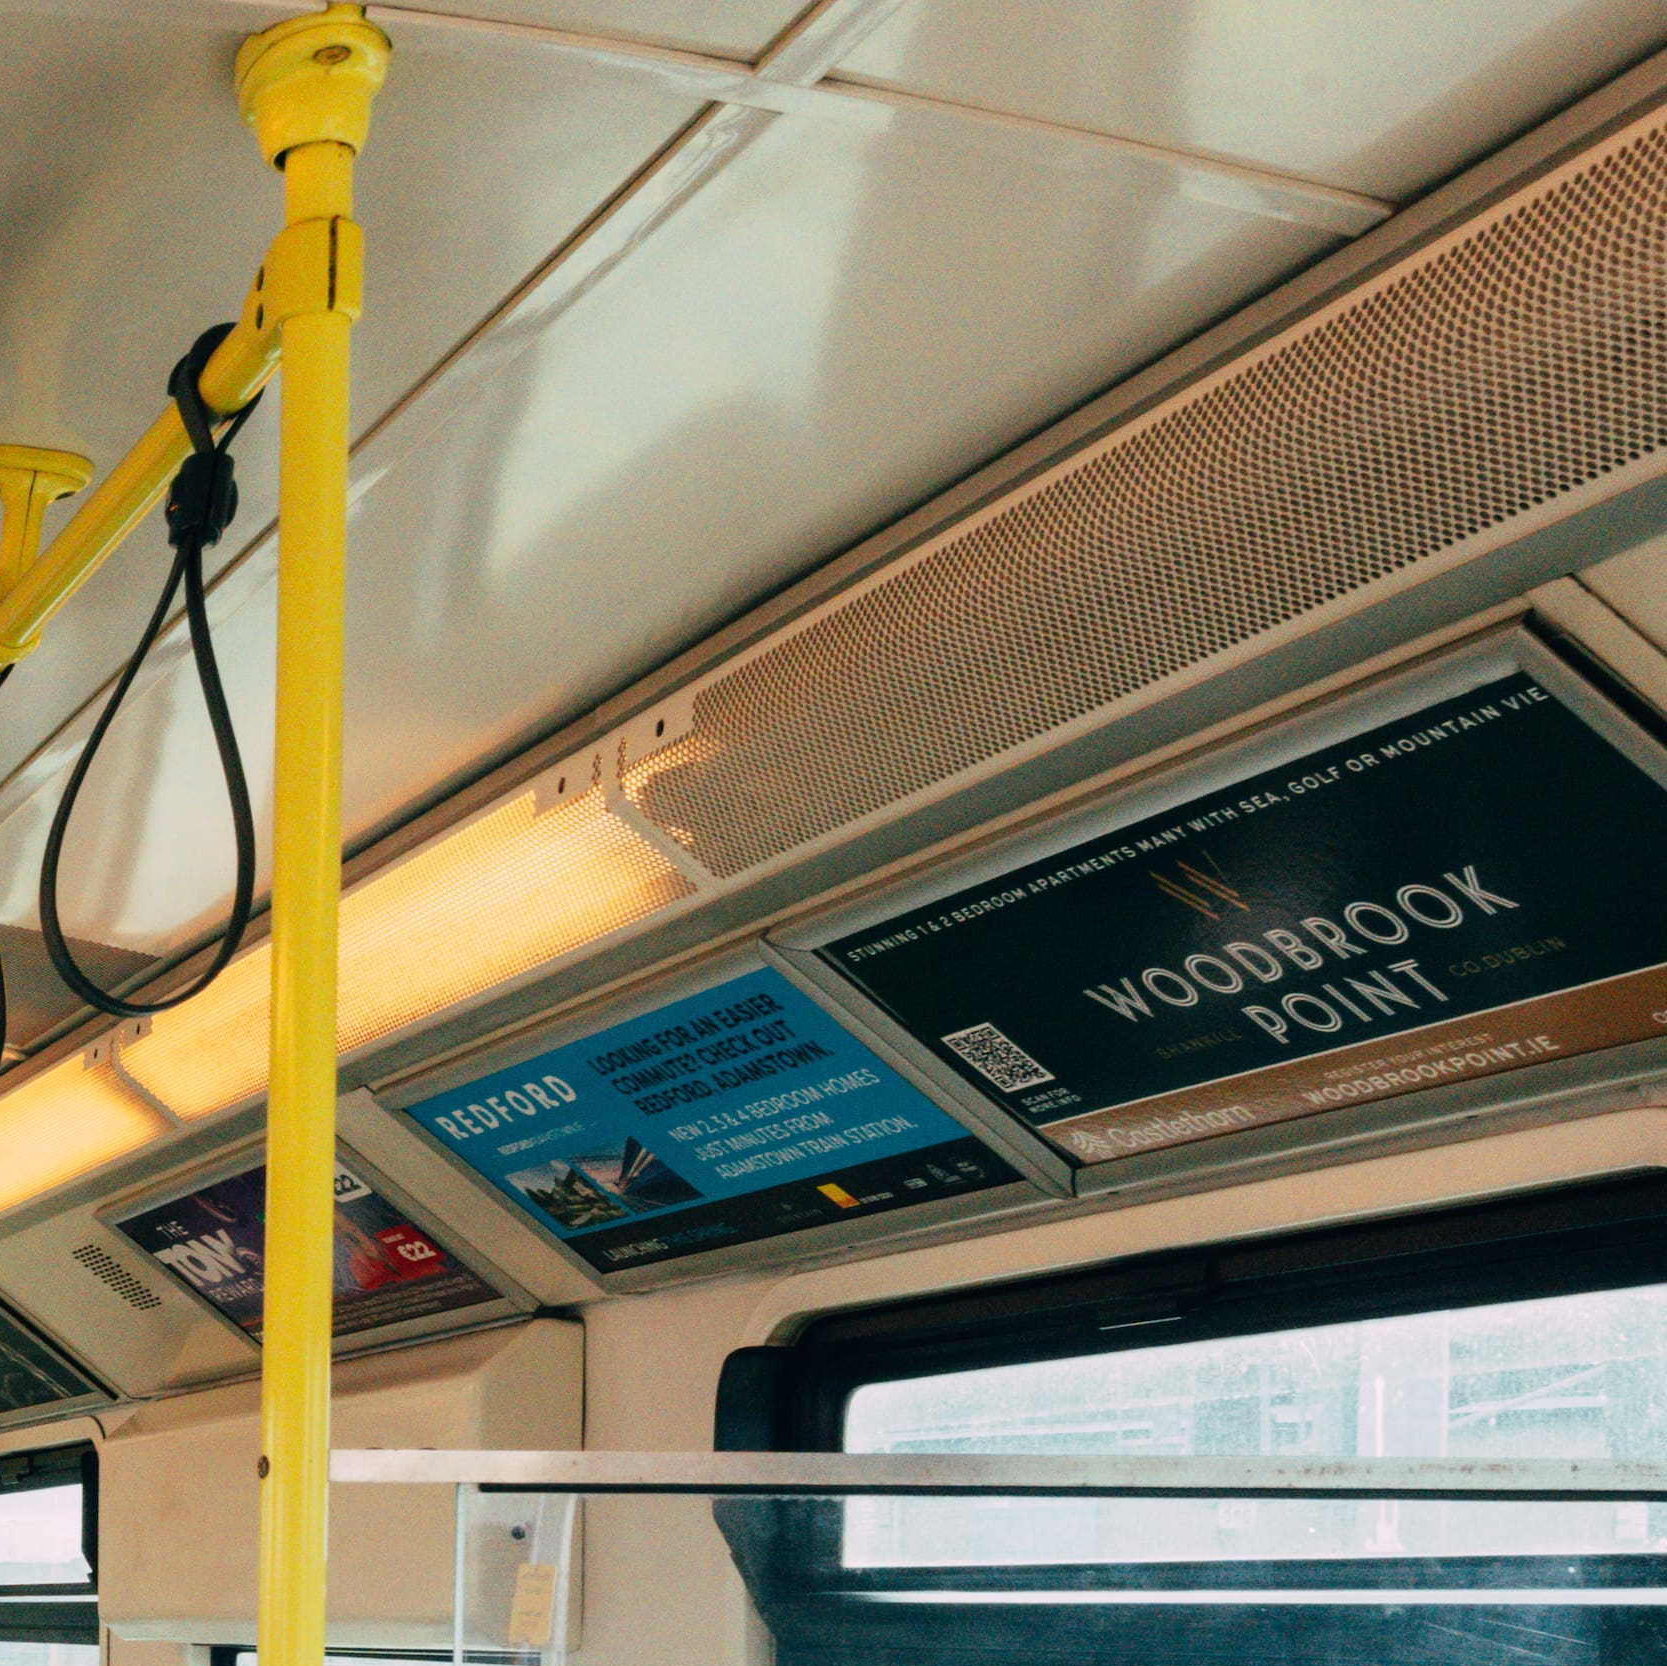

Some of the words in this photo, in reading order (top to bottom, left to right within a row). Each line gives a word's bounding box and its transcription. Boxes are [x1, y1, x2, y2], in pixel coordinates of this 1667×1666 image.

[847, 929, 919, 961] STUNNING
[917, 926, 928, 934] 1
[926, 921, 941, 931] &
[938, 916, 953, 926] 2
[951, 888, 1028, 921] BEDROOM
[1025, 846, 1137, 893] APARTMENTS
[1135, 826, 1189, 851] MANY
[1187, 807, 1238, 831] WITH
[1238, 789, 1288, 813] SEA,
[1286, 766, 1345, 794] GOLF
[1344, 753, 1380, 772] OR
[1379, 706, 1502, 758] MOUNTAIN
[1086, 868, 1519, 1023] WOODBROOK
[587, 1038, 662, 1074] LOOKING
[654, 1026, 694, 1049] FOR
[688, 1016, 720, 1037] AN
[713, 993, 781, 1027] EASIER
[1245, 962, 1452, 1042] POINT
[610, 1053, 703, 1094] COMMUTE?
[695, 1034, 758, 1065] CHECK
[750, 1020, 797, 1045] OUT
[635, 1078, 719, 1116] REDFORD,
[708, 1040, 833, 1090] ADAMSTOWN.
[1301, 1035, 1560, 1105] WOODBROOKPOINT.IE
[1323, 1058, 1390, 1079] REGISTER
[1423, 1033, 1494, 1055] INTEREST
[436, 1075, 578, 1139] REDFORD
[669, 1123, 704, 1141] NEW
[710, 1115, 728, 1129] 3
[721, 1112, 740, 1125] &
[733, 1108, 749, 1120] 4
[745, 1086, 823, 1118] BEDROOM
[817, 1068, 879, 1095] HOMES
[691, 1141, 730, 1160] JUST
[723, 1123, 788, 1150] MINUTES
[783, 1110, 833, 1133] FROM
[1107, 1099, 1254, 1148] Castlethorn
[714, 1145, 805, 1178] ADAMSTOWN
[799, 1133, 848, 1155] TRAIN
[843, 1114, 917, 1143] STATION.
[156, 1221, 189, 1239] THE
[397, 1241, 437, 1261] €22
[602, 1238, 668, 1261] LAUNCHING
